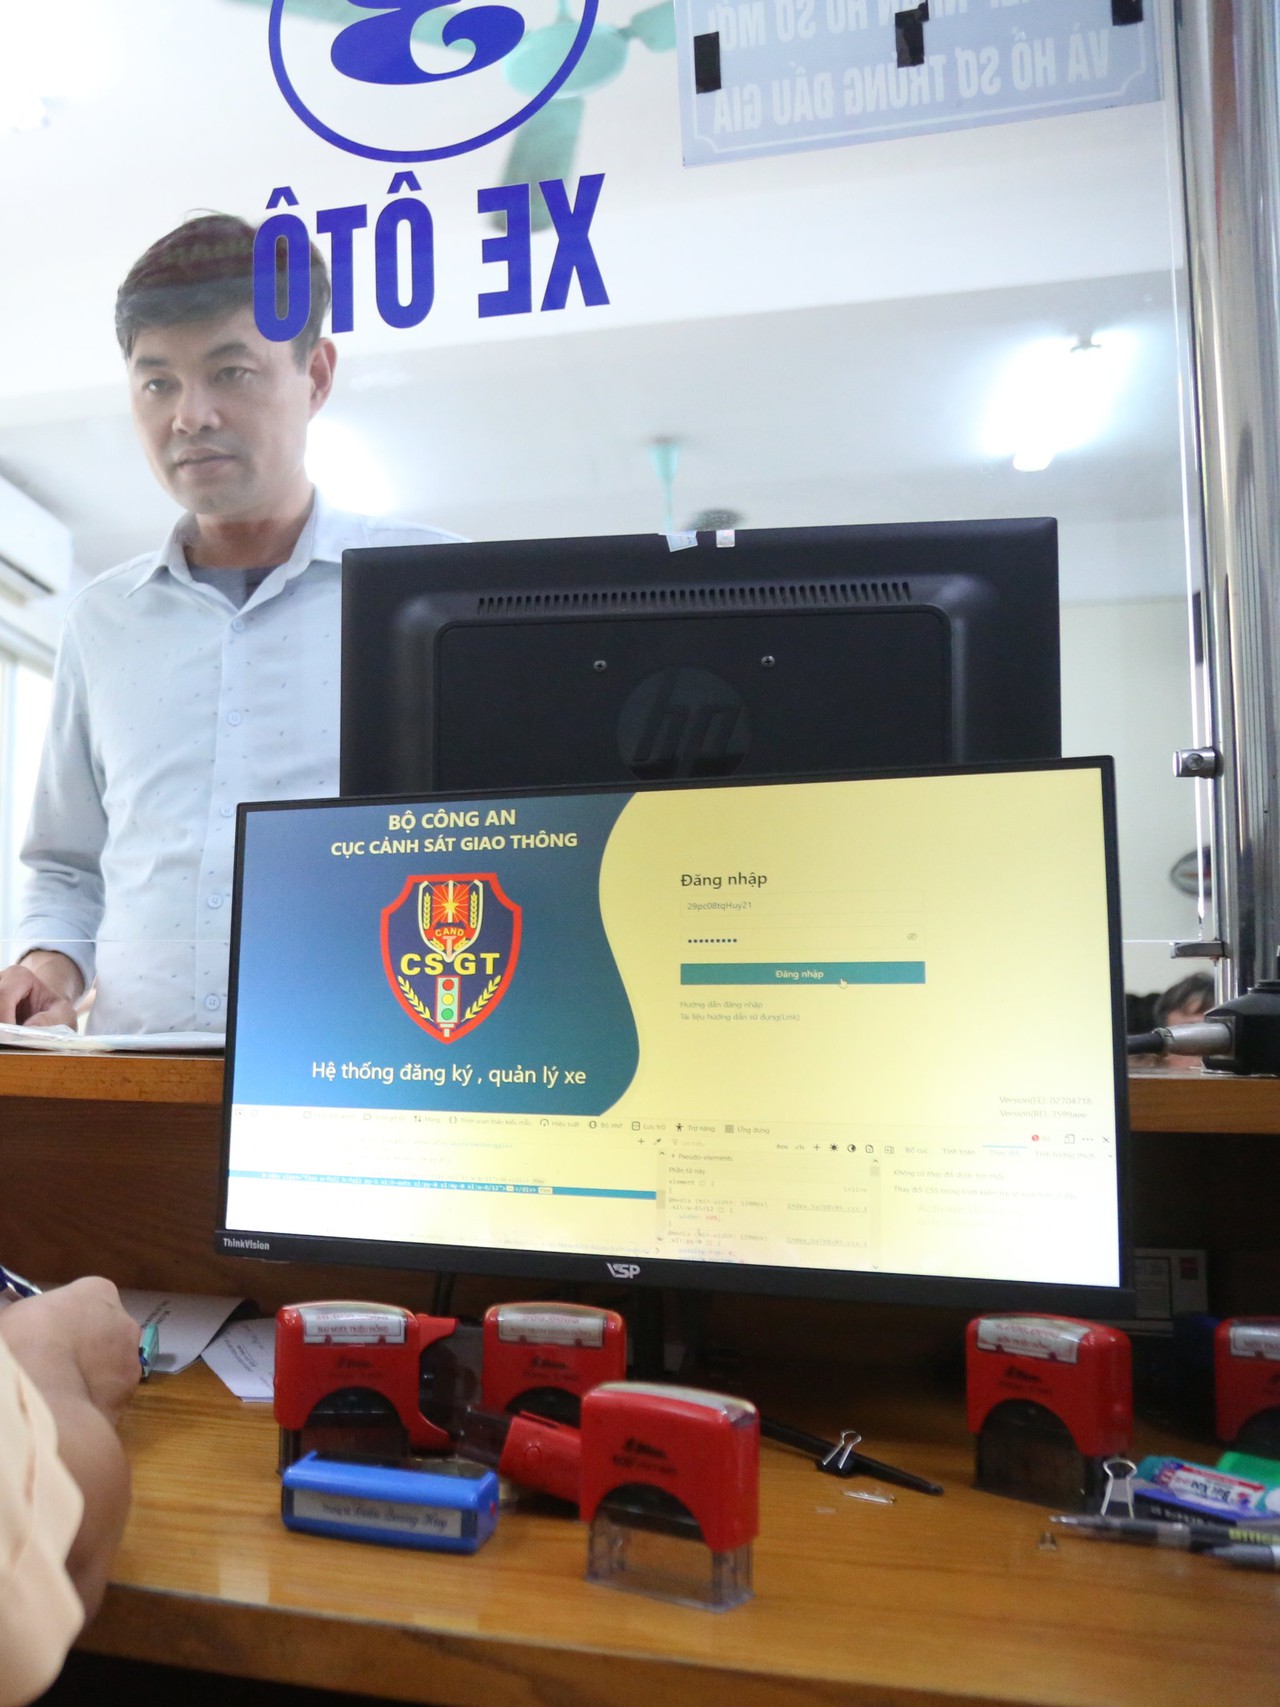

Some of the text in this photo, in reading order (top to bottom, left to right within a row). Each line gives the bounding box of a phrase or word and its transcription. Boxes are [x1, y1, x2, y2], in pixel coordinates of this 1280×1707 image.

[388, 808, 517, 834] BỘ CÔNG AN
[330, 829, 579, 859] CỤC CẢNH SÁT GIAO THÔNG
[680, 871, 768, 890] Đăng nhập
[435, 927, 465, 938] CAND
[775, 969, 824, 981] Đăng nhập
[744, 1000, 763, 1010] nhập
[311, 1061, 337, 1082] Hệ
[340, 1062, 394, 1085] thống
[399, 1062, 446, 1086] đăng
[451, 1063, 474, 1087] ký
[488, 1065, 537, 1088] quản
[542, 1065, 560, 1089] lý
[563, 1074, 587, 1085] xe
[223, 1237, 270, 1251] ThinkVision
